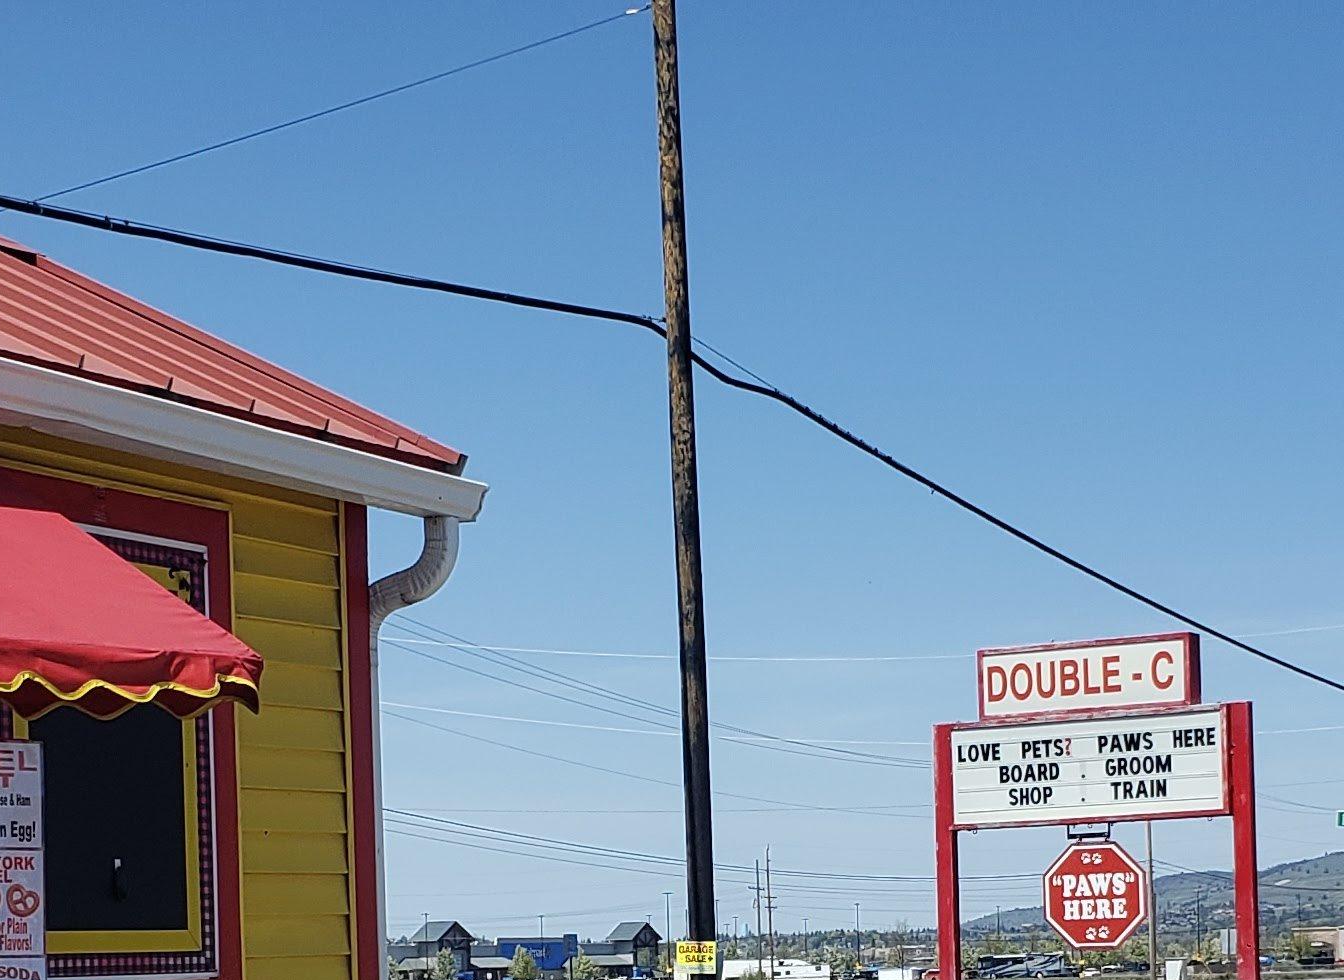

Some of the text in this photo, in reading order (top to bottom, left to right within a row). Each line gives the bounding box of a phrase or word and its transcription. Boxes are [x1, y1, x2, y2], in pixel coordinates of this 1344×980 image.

[987, 655, 1121, 702] DOUBLE
[1151, 651, 1174, 690] C
[957, 727, 1216, 763] LOVE PETS? PAWS HERE
[999, 754, 1172, 784] BOARD GROOM
[10, 794, 15, 806] &
[16, 795, 31, 806] Ham
[1008, 778, 1167, 807] SHOP TRAIN
[10, 820, 36, 842] Egg!
[1052, 872, 1135, 898] "PAWS"
[1062, 899, 1128, 921] HERE
[7, 918, 27, 934] Plain
[0, 935, 32, 951] Flavors!
[679, 945, 713, 953] GARAGE
[685, 954, 706, 962] SALE
